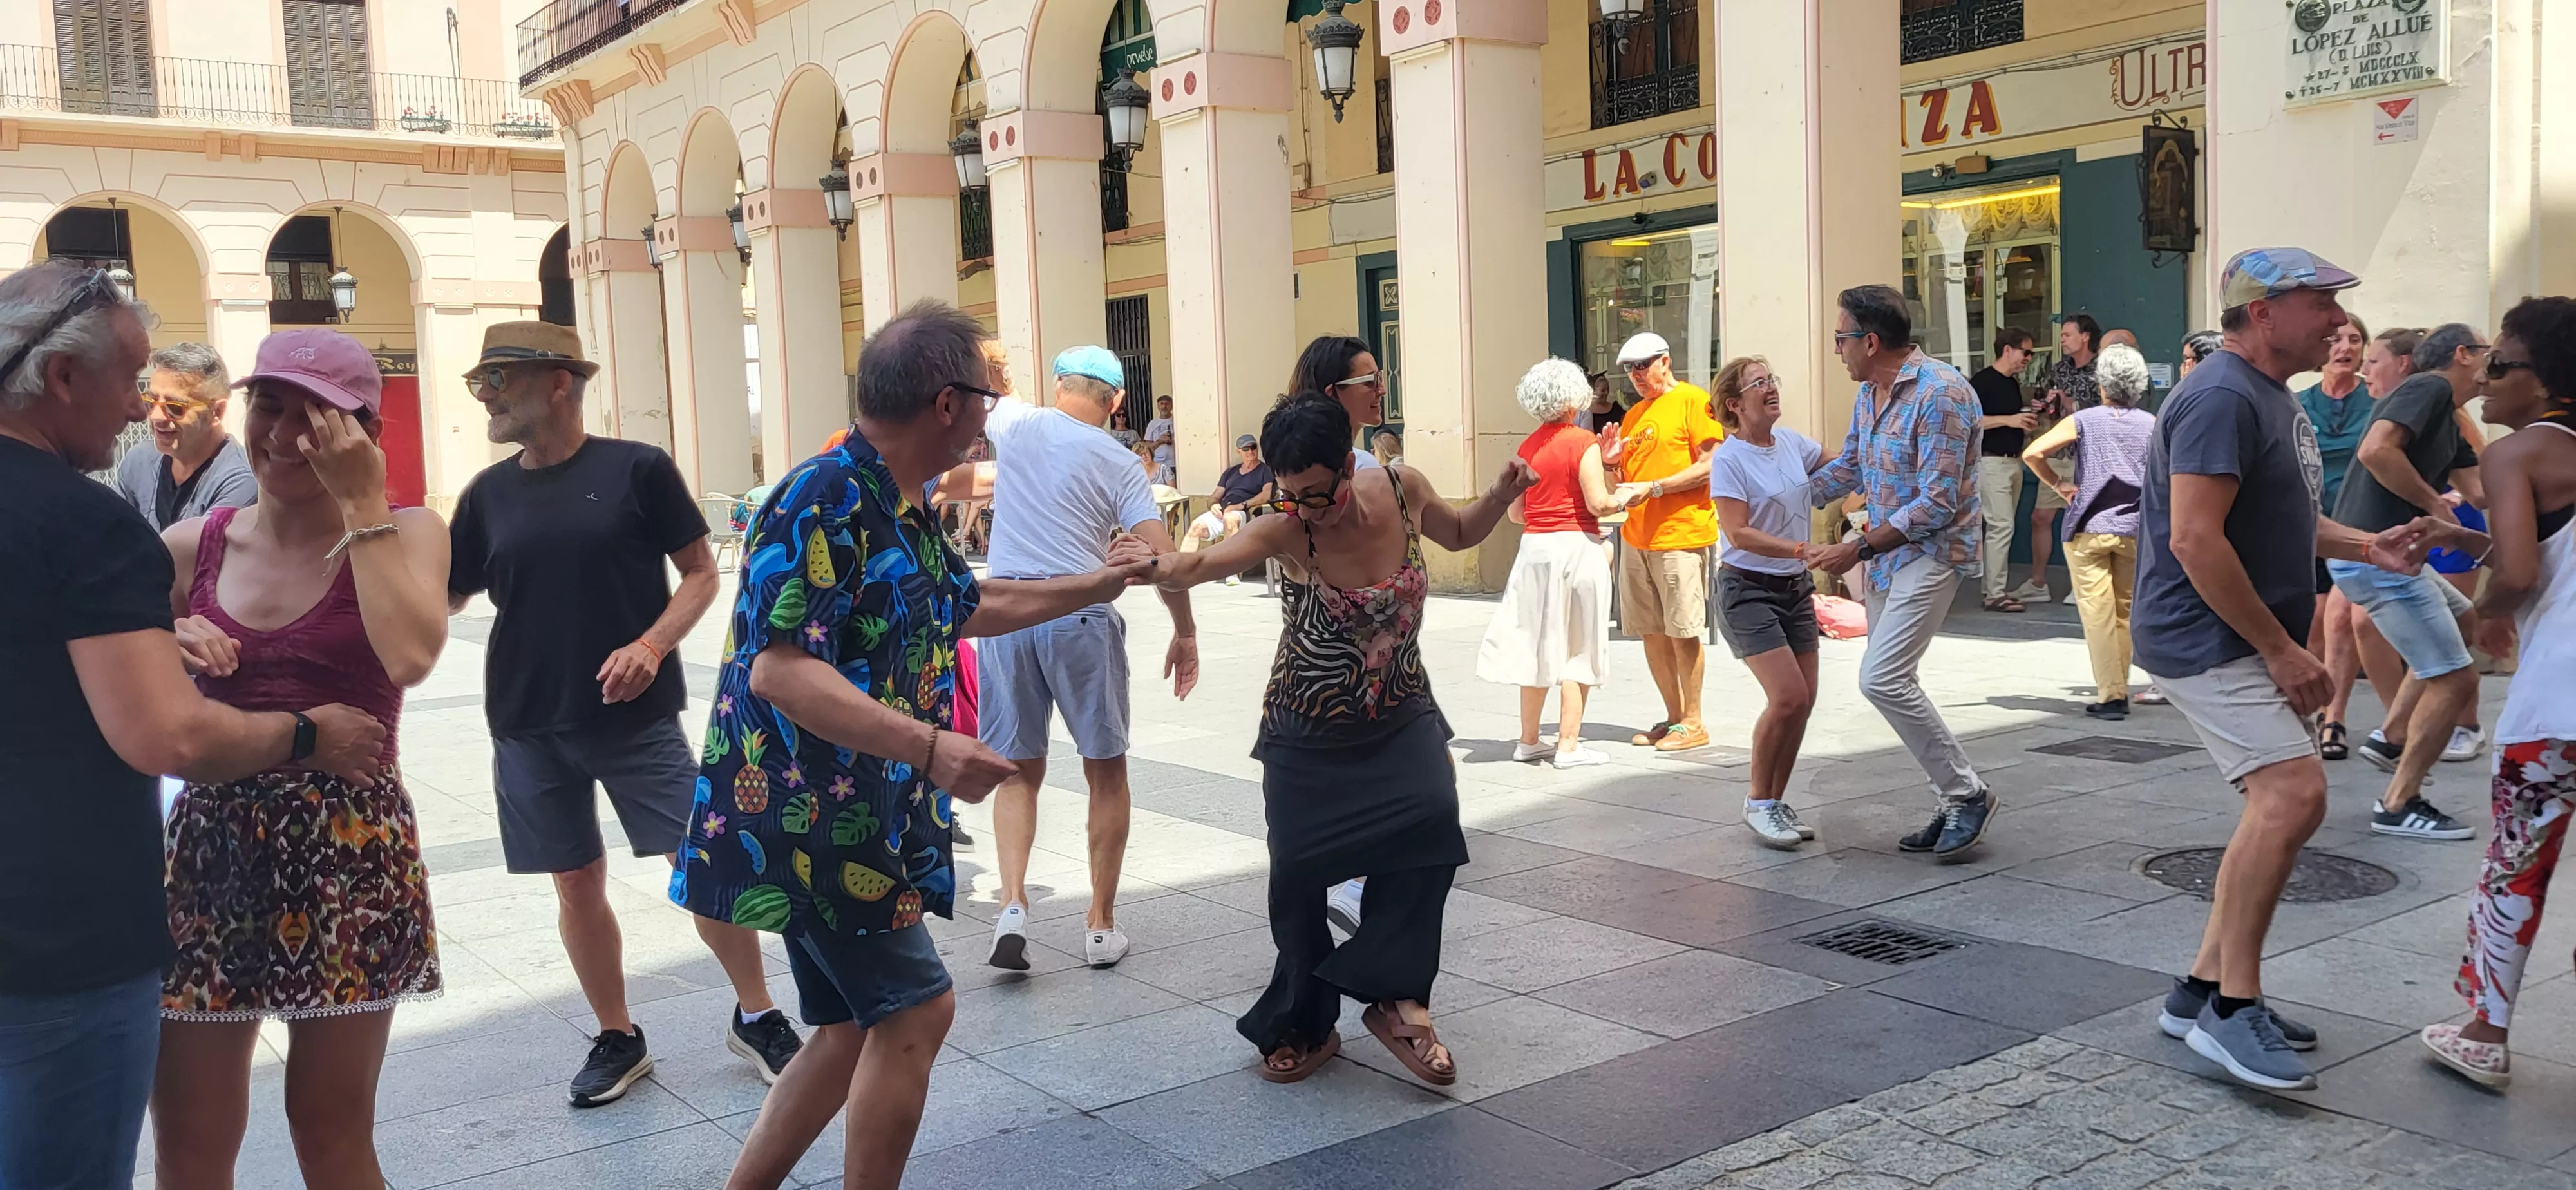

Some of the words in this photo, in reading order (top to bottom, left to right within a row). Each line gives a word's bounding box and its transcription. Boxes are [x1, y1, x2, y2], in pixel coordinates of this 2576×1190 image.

[2293, 28, 2356, 54] LÓPEZ
[2367, 11, 2433, 41] ALLUÉ
[2349, 66, 2423, 89] MCMXXVIII
[1582, 149, 1641, 202] LA
